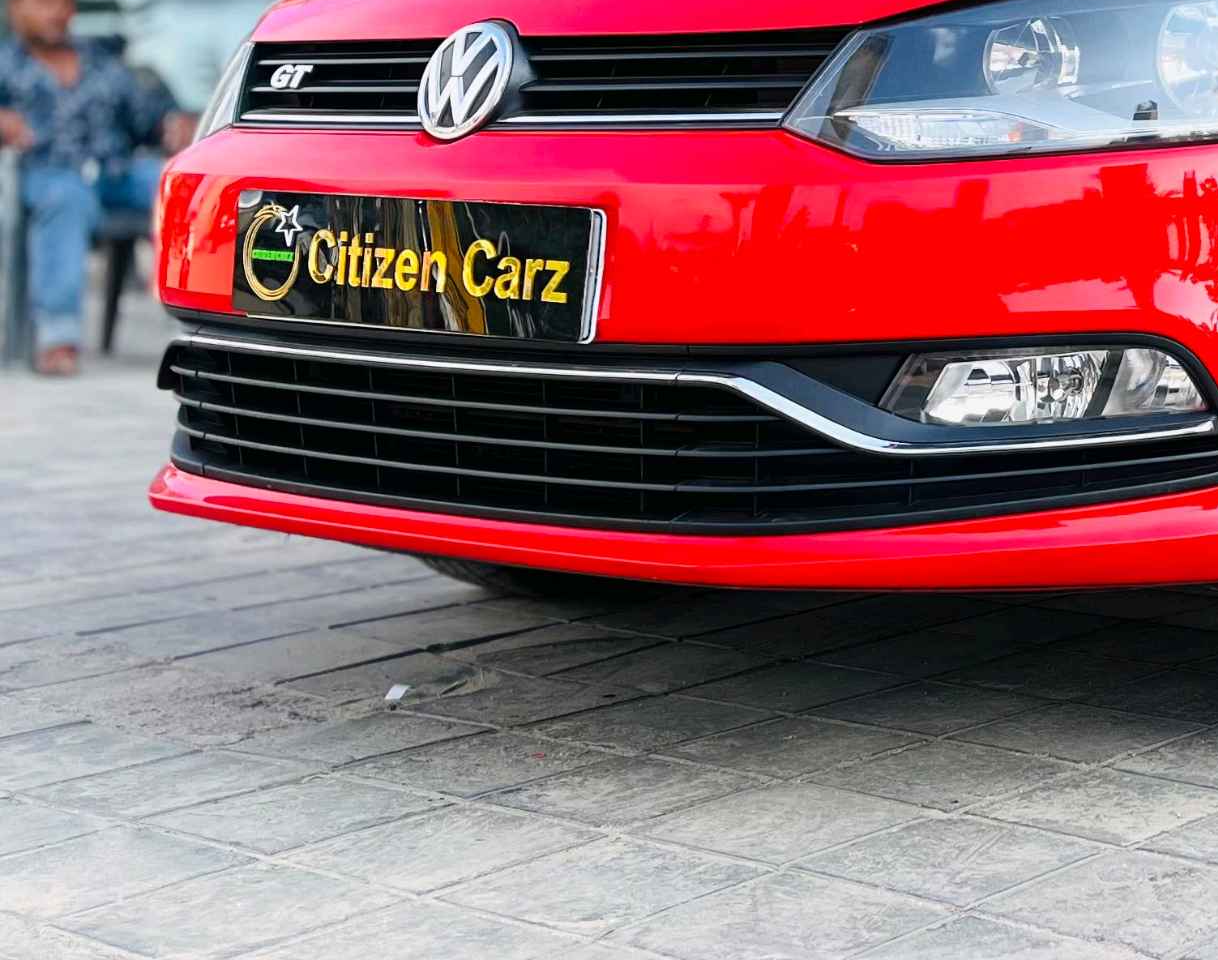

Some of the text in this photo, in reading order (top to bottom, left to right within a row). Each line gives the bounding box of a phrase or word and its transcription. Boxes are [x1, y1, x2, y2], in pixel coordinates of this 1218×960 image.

[269, 64, 314, 89] GT
[417, 22, 514, 140] VW
[308, 229, 570, 304] Citizen Carz
